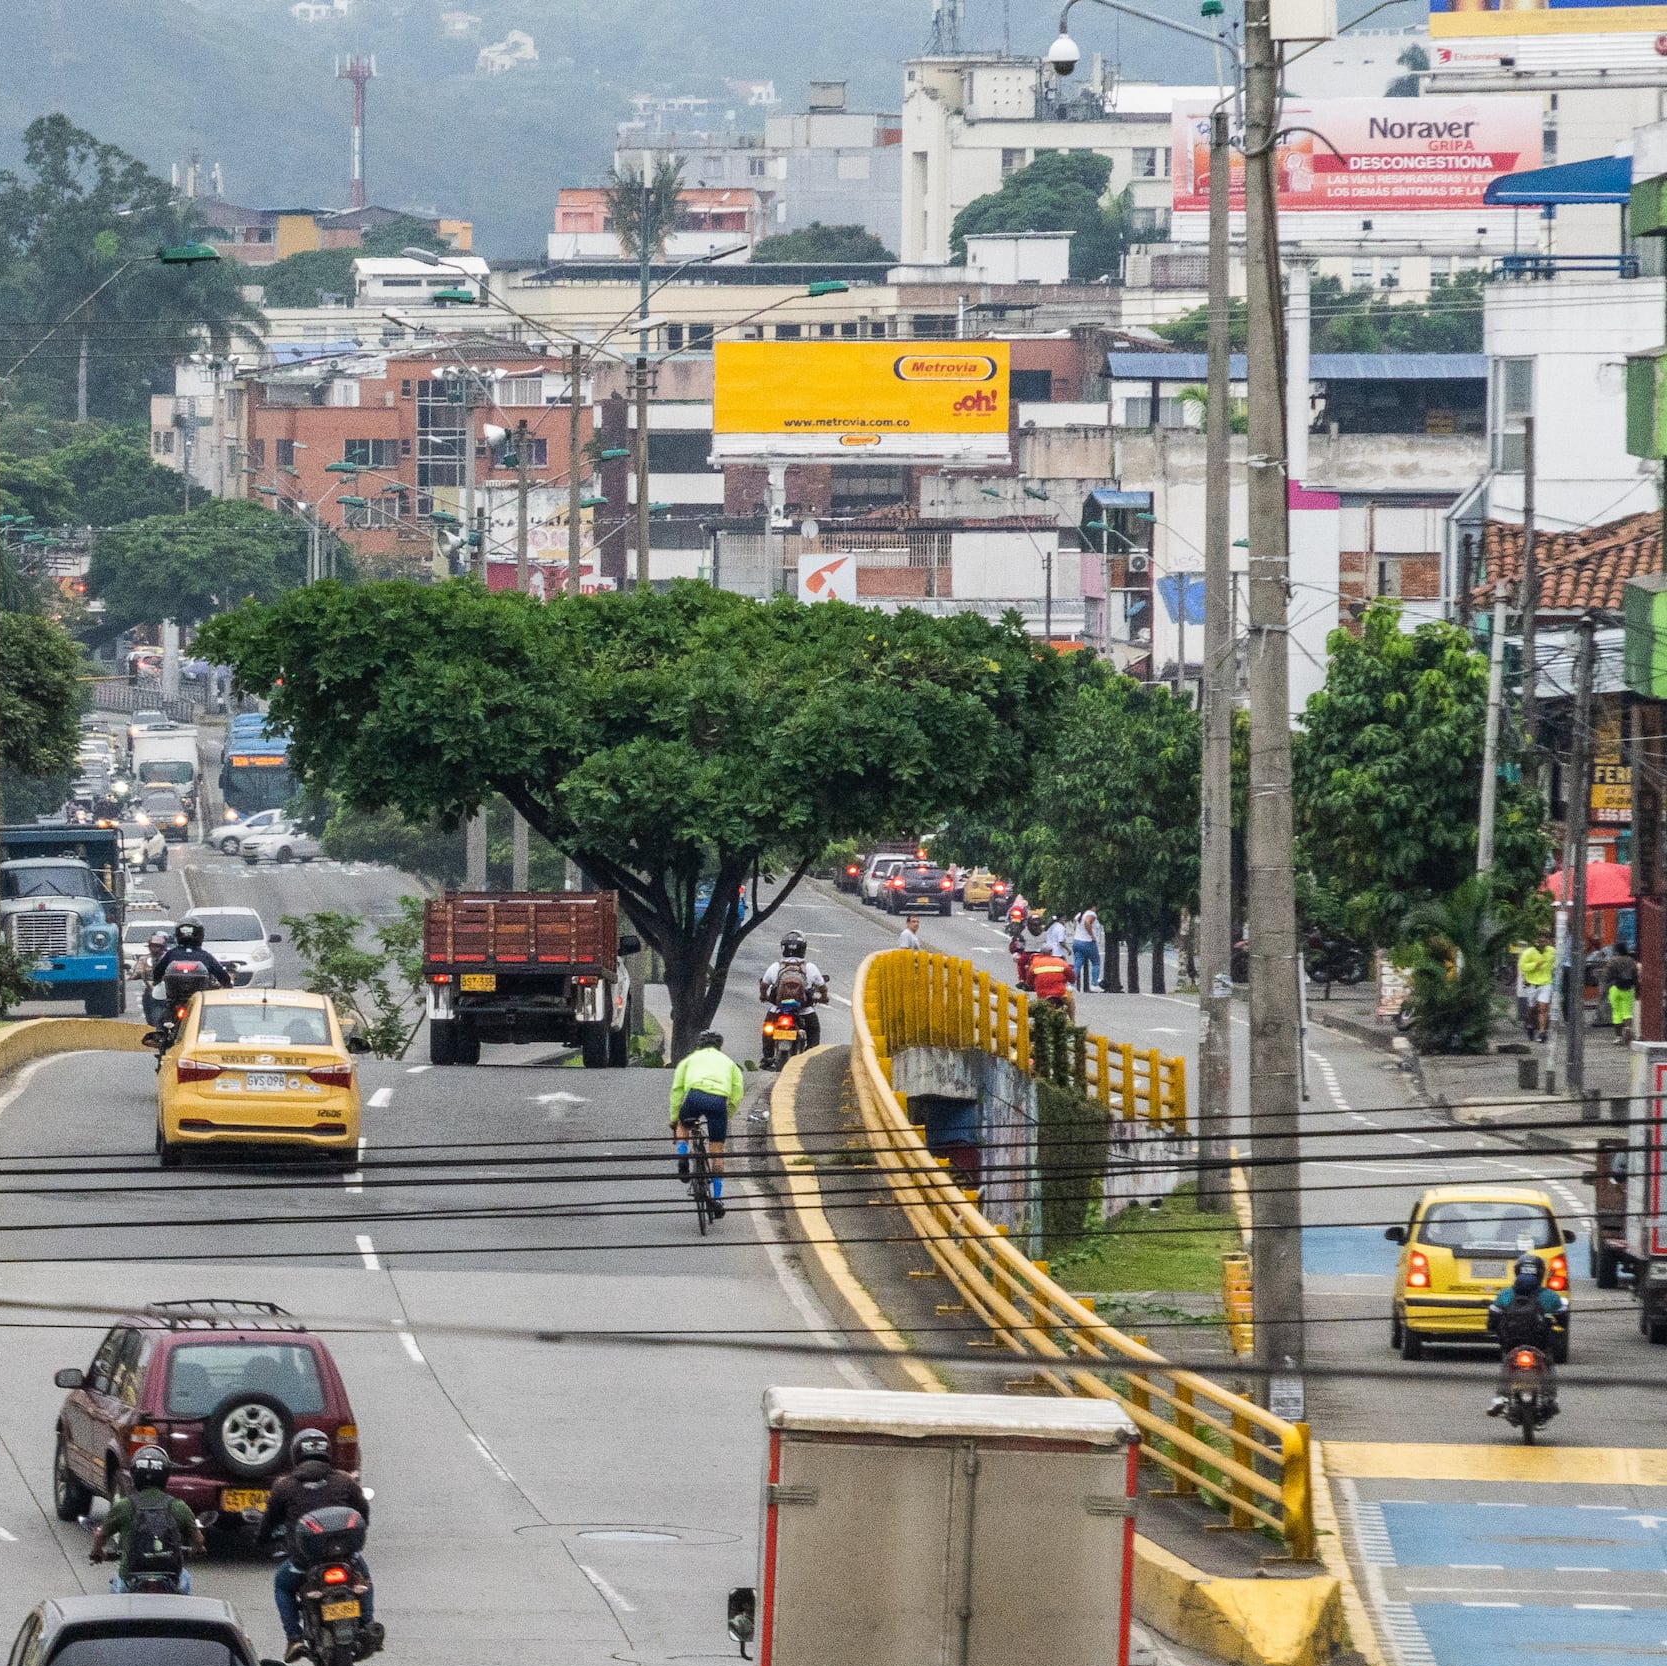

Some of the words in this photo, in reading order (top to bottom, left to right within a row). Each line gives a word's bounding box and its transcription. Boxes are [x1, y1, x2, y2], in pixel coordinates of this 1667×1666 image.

[1369, 118, 1476, 139] Noraver
[1428, 140, 1475, 151] GRIPA
[1349, 155, 1493, 171] DESCONGESTIONA
[1327, 174, 1349, 184] LAS
[1377, 174, 1461, 183] RESPIRATORIAS
[1327, 187, 1350, 197] LOS
[1450, 186, 1463, 195] DE
[1467, 186, 1481, 195] LA
[912, 361, 978, 372] Metrovia
[784, 417, 910, 427] www.metrovia.com.co
